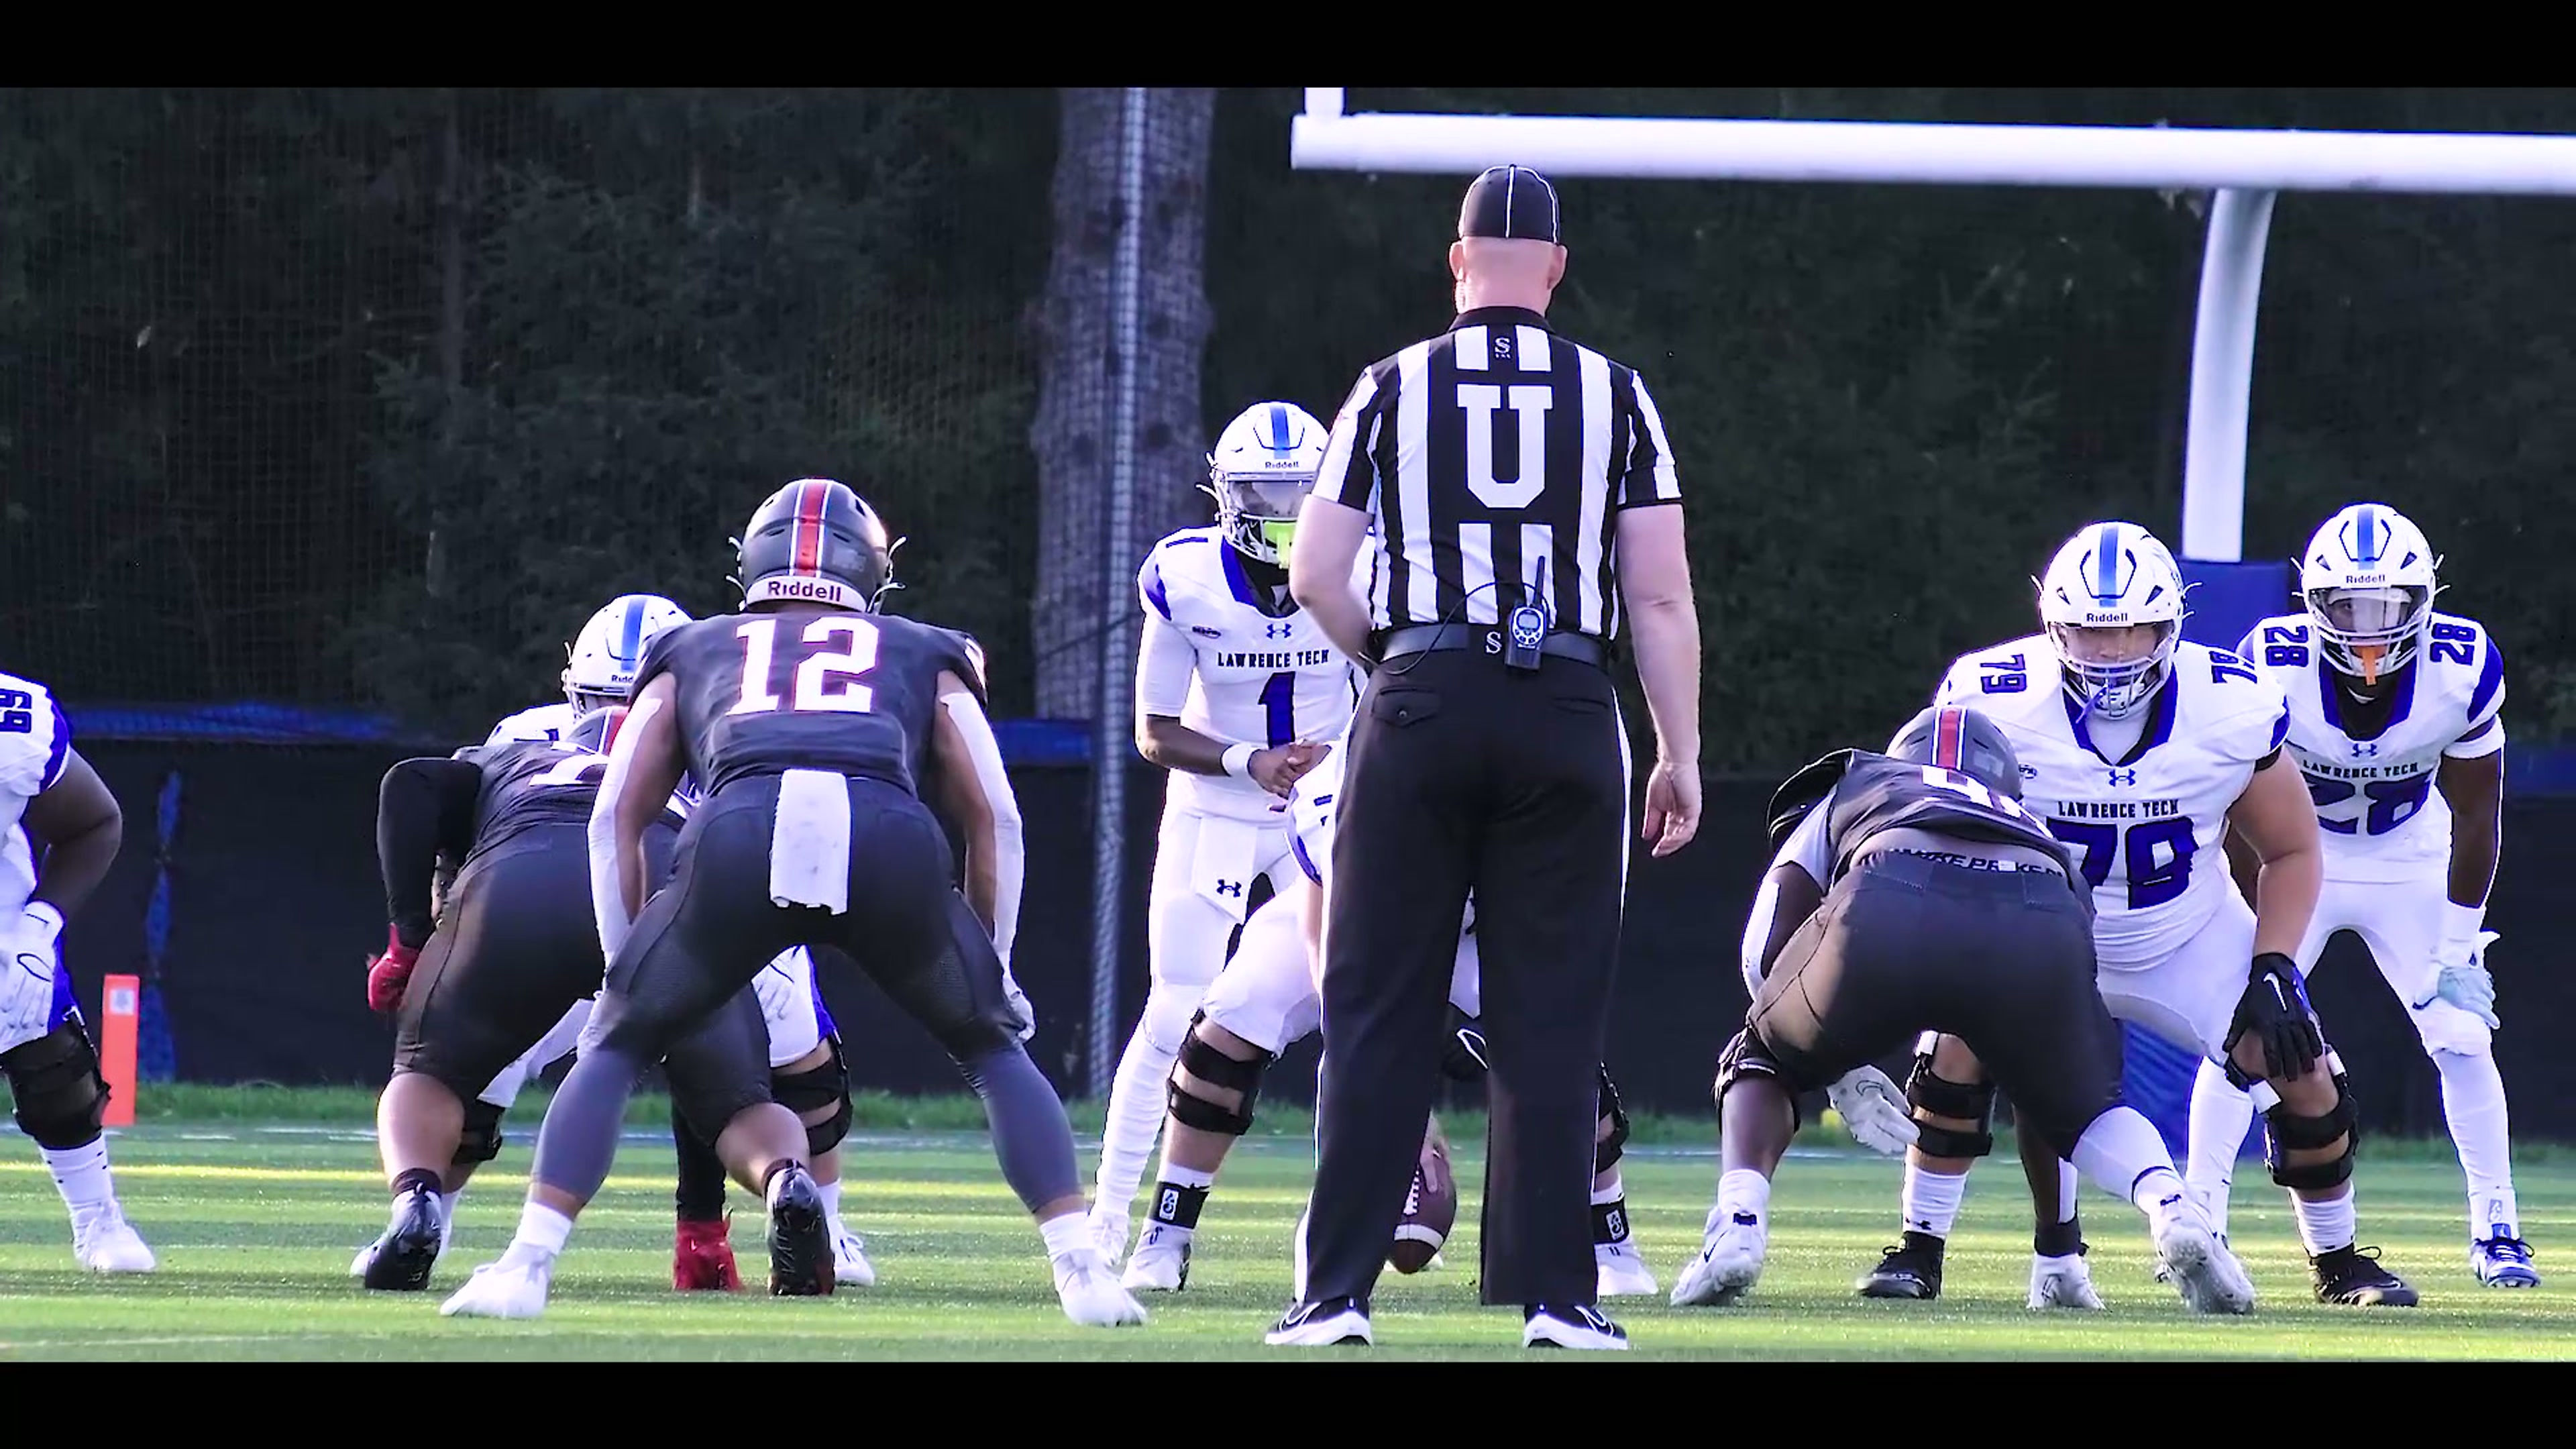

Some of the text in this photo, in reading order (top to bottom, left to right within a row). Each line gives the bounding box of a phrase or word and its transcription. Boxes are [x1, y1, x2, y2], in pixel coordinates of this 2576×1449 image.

[1457, 384, 1553, 508] U
[768, 581, 841, 602] Riddell
[2347, 574, 2385, 583] Riddell
[2086, 613, 2127, 622] Riddell
[1218, 649, 1330, 667] LAWRENCE TECH
[2263, 625, 2309, 667] 28
[2430, 623, 2476, 666] 28
[726, 616, 879, 716] 12
[1980, 653, 2027, 694] 79
[1257, 671, 1295, 749] 1
[2303, 759, 2418, 778] LAWRENCE TECH
[2058, 799, 2179, 818] LAWRENCE TECH
[2300, 769, 2434, 836] 28
[2047, 816, 2200, 910] 79
